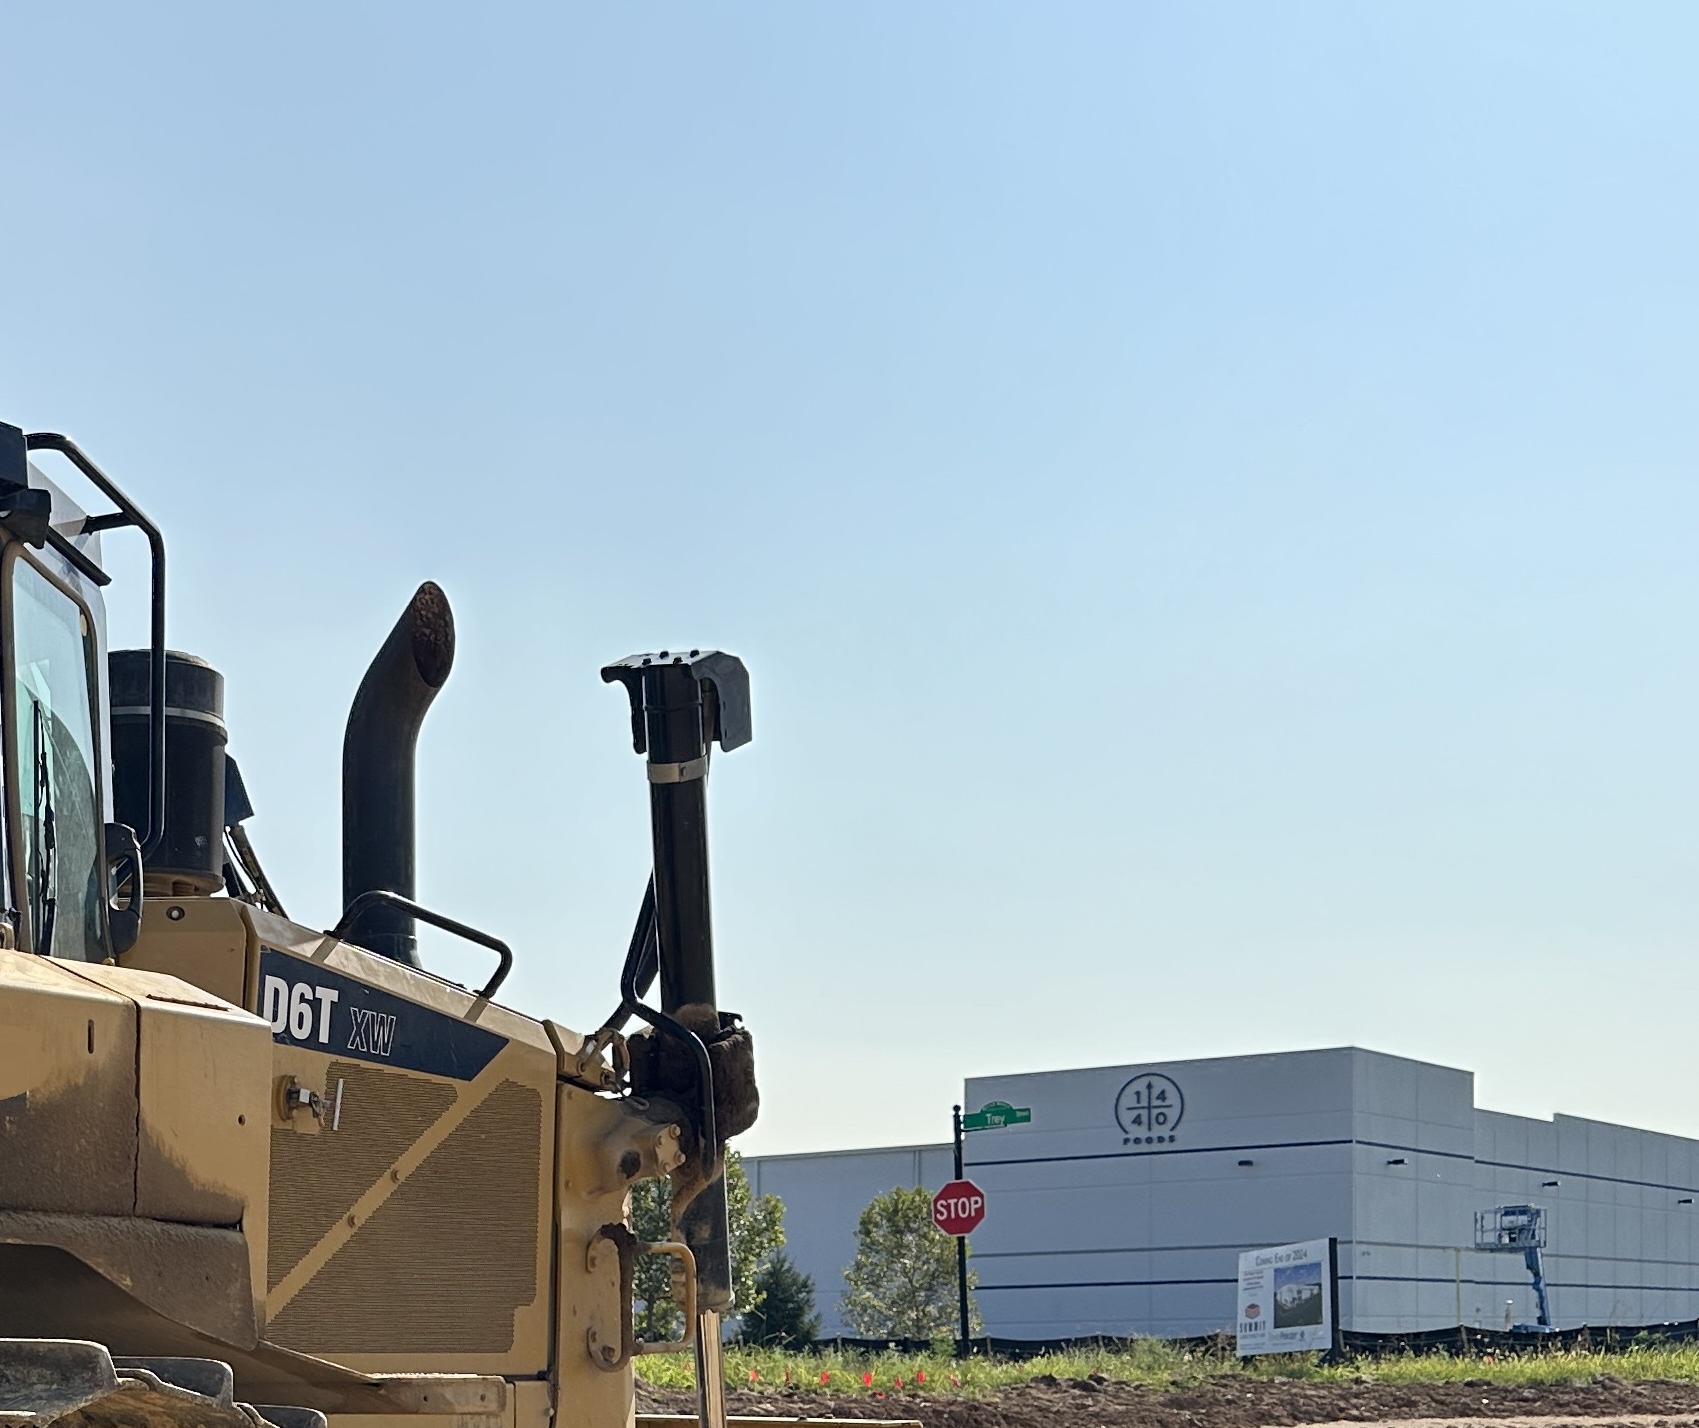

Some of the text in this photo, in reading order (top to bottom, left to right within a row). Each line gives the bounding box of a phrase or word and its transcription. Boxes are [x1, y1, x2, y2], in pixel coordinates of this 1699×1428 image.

[263, 974, 397, 1056] D6T XW
[985, 1113, 1006, 1126] Trey
[1123, 1134, 1176, 1145] FOODS
[936, 1196, 982, 1220] STOP
